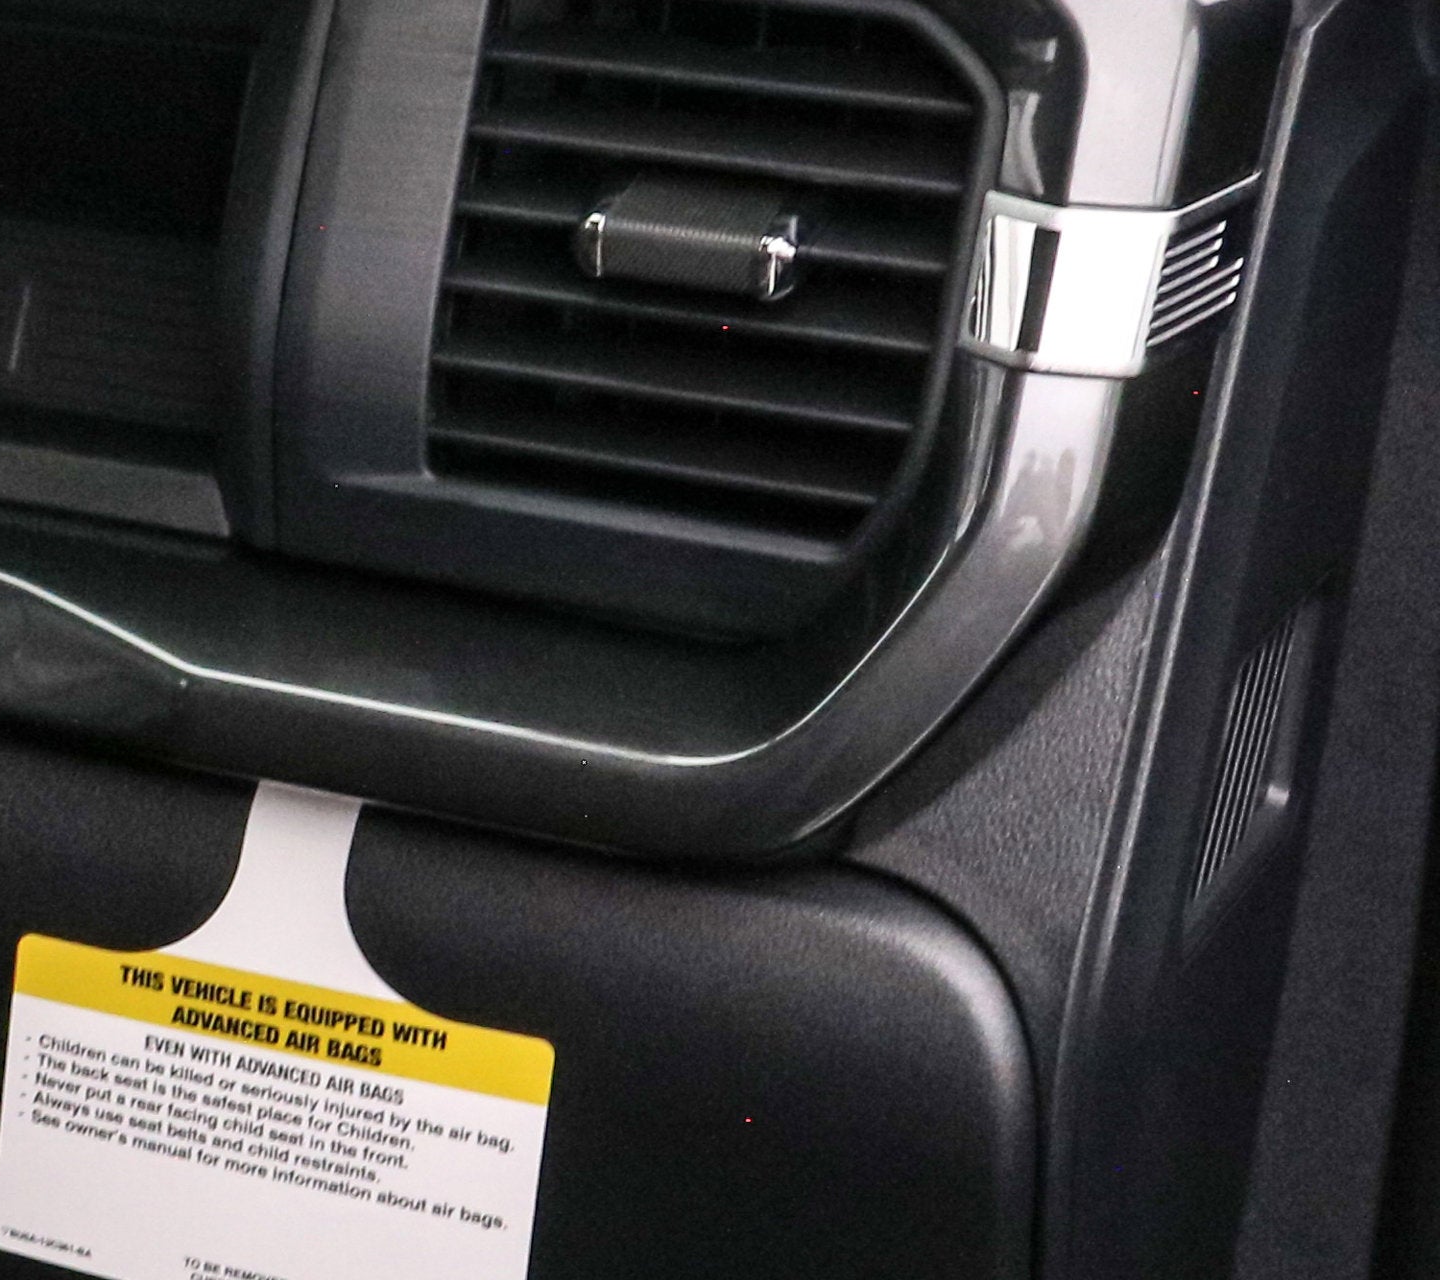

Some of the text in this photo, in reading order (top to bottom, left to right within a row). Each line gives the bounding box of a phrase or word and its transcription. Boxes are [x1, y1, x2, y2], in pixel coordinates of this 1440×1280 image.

[120, 965, 447, 1050] THIS VEHICLE IS EQUIPPED WITH
[171, 1005, 382, 1067] ADVANCED AIR BAGS
[38, 1033, 107, 1062] Children
[110, 1054, 140, 1071] can
[145, 1058, 165, 1076] be
[169, 1063, 215, 1087] killed
[217, 1078, 237, 1092] or
[240, 1083, 319, 1112] seriously
[323, 1098, 385, 1124] injured
[389, 1112, 411, 1132] by
[416, 1118, 444, 1136] the
[448, 1126, 472, 1142] air
[39, 1052, 67, 1072] The
[70, 1060, 109, 1081] back
[113, 1073, 148, 1091] seat
[152, 1079, 167, 1096] is
[171, 1084, 197, 1103] the
[201, 1094, 253, 1115] safest
[256, 1106, 303, 1126] place
[307, 1114, 333, 1132] for
[144, 1034, 404, 1105] EVEN WITH ADVANCED AIR BAGS
[32, 1090, 90, 1117] Always
[94, 1107, 124, 1125] use
[128, 1116, 163, 1134] seat
[167, 1122, 207, 1145] belts
[211, 1136, 244, 1153] and
[247, 1143, 290, 1163] child
[34, 1071, 82, 1095] Never
[85, 1086, 112, 1103] put
[115, 1093, 126, 1106] a
[129, 1097, 163, 1114] rear
[167, 1102, 219, 1129] facing
[222, 1117, 265, 1138] child
[268, 1129, 304, 1146] seat
[309, 1135, 325, 1151] in
[330, 1139, 357, 1158] the
[31, 1108, 61, 1128] See
[64, 1120, 127, 1145] owner's
[131, 1136, 193, 1160] manual
[197, 1148, 220, 1167] for
[224, 1158, 268, 1178] more
[272, 1166, 371, 1201] information
[376, 1191, 427, 1212] about
[431, 1202, 455, 1218] air
[184, 1256, 201, 1270] TO
[203, 1261, 221, 1274] BE
